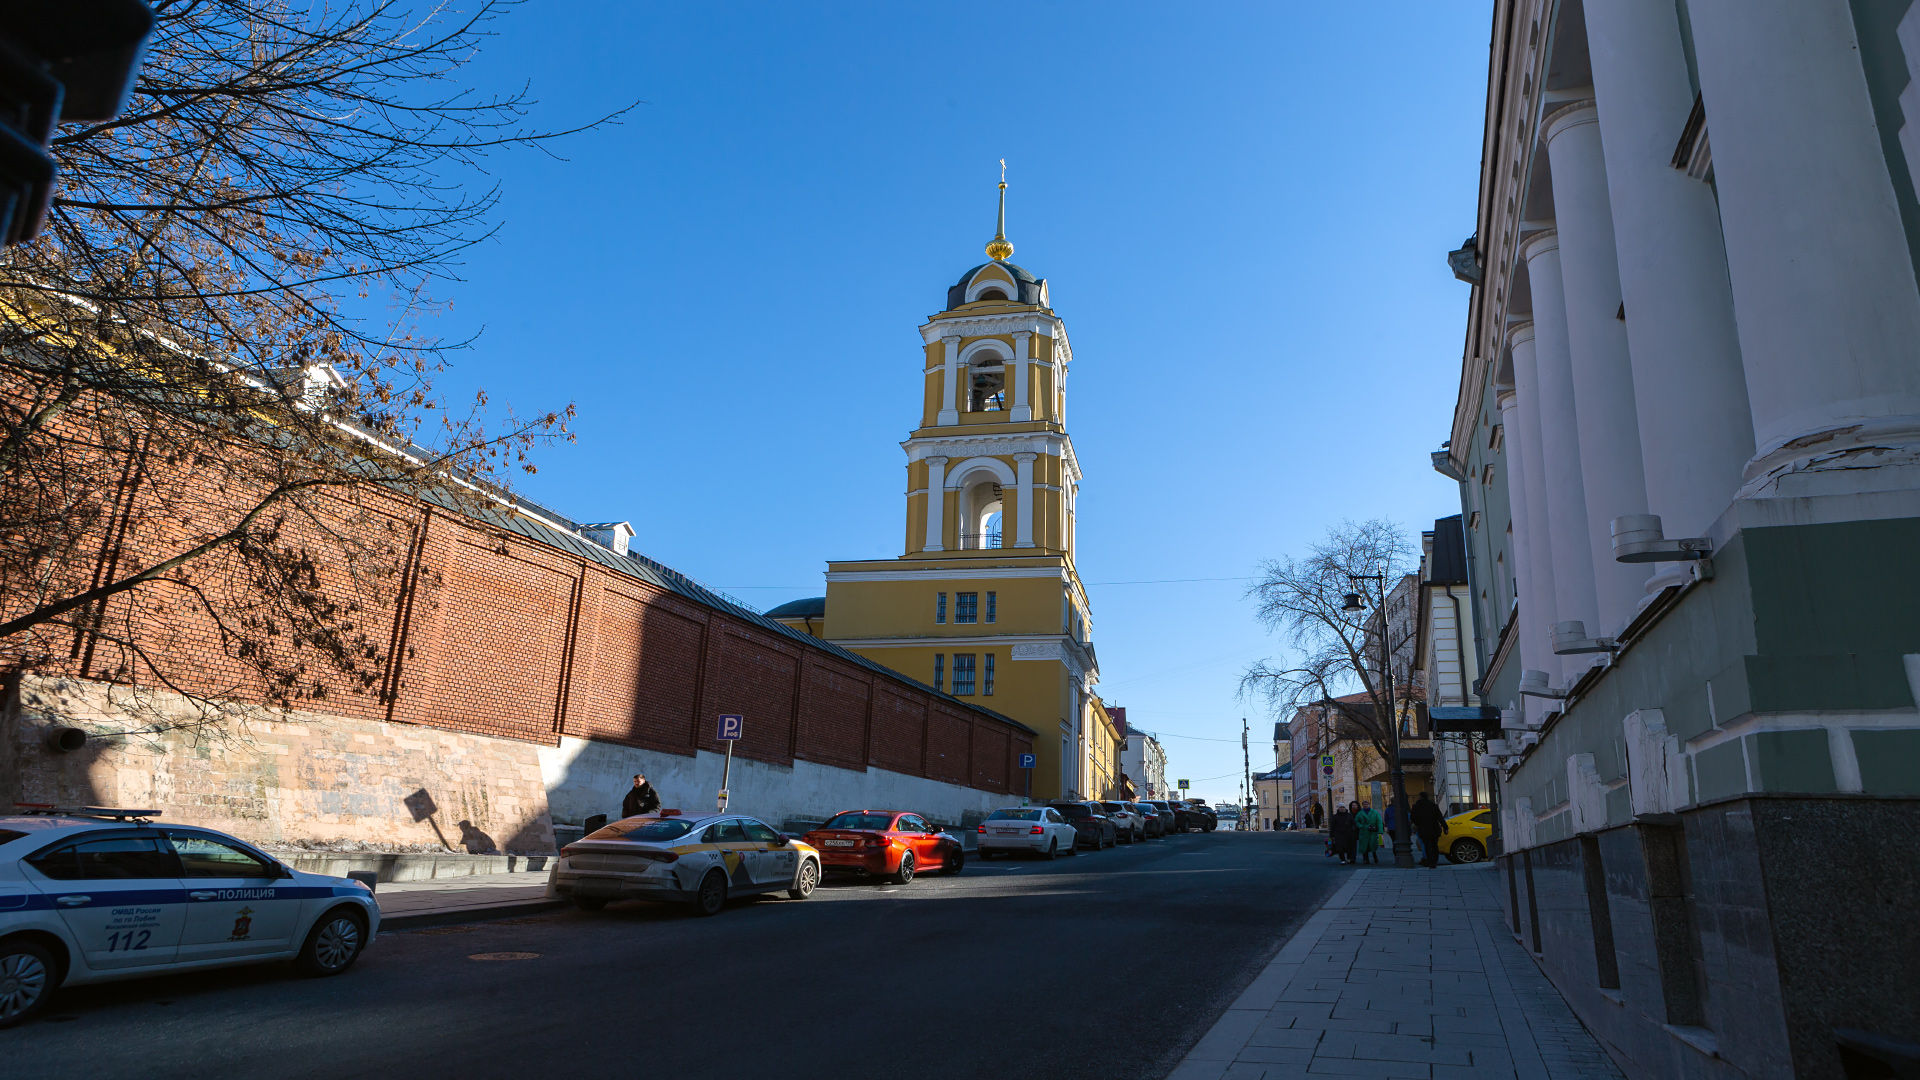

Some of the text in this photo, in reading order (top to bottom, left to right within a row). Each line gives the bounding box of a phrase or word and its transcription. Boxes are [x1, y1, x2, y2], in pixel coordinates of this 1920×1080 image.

[723, 717, 738, 737] P
[1023, 755, 1033, 766] P
[217, 888, 275, 900] ПОЛИЦИЯ
[111, 907, 162, 916] ОМВД России
[107, 929, 152, 953] 112
